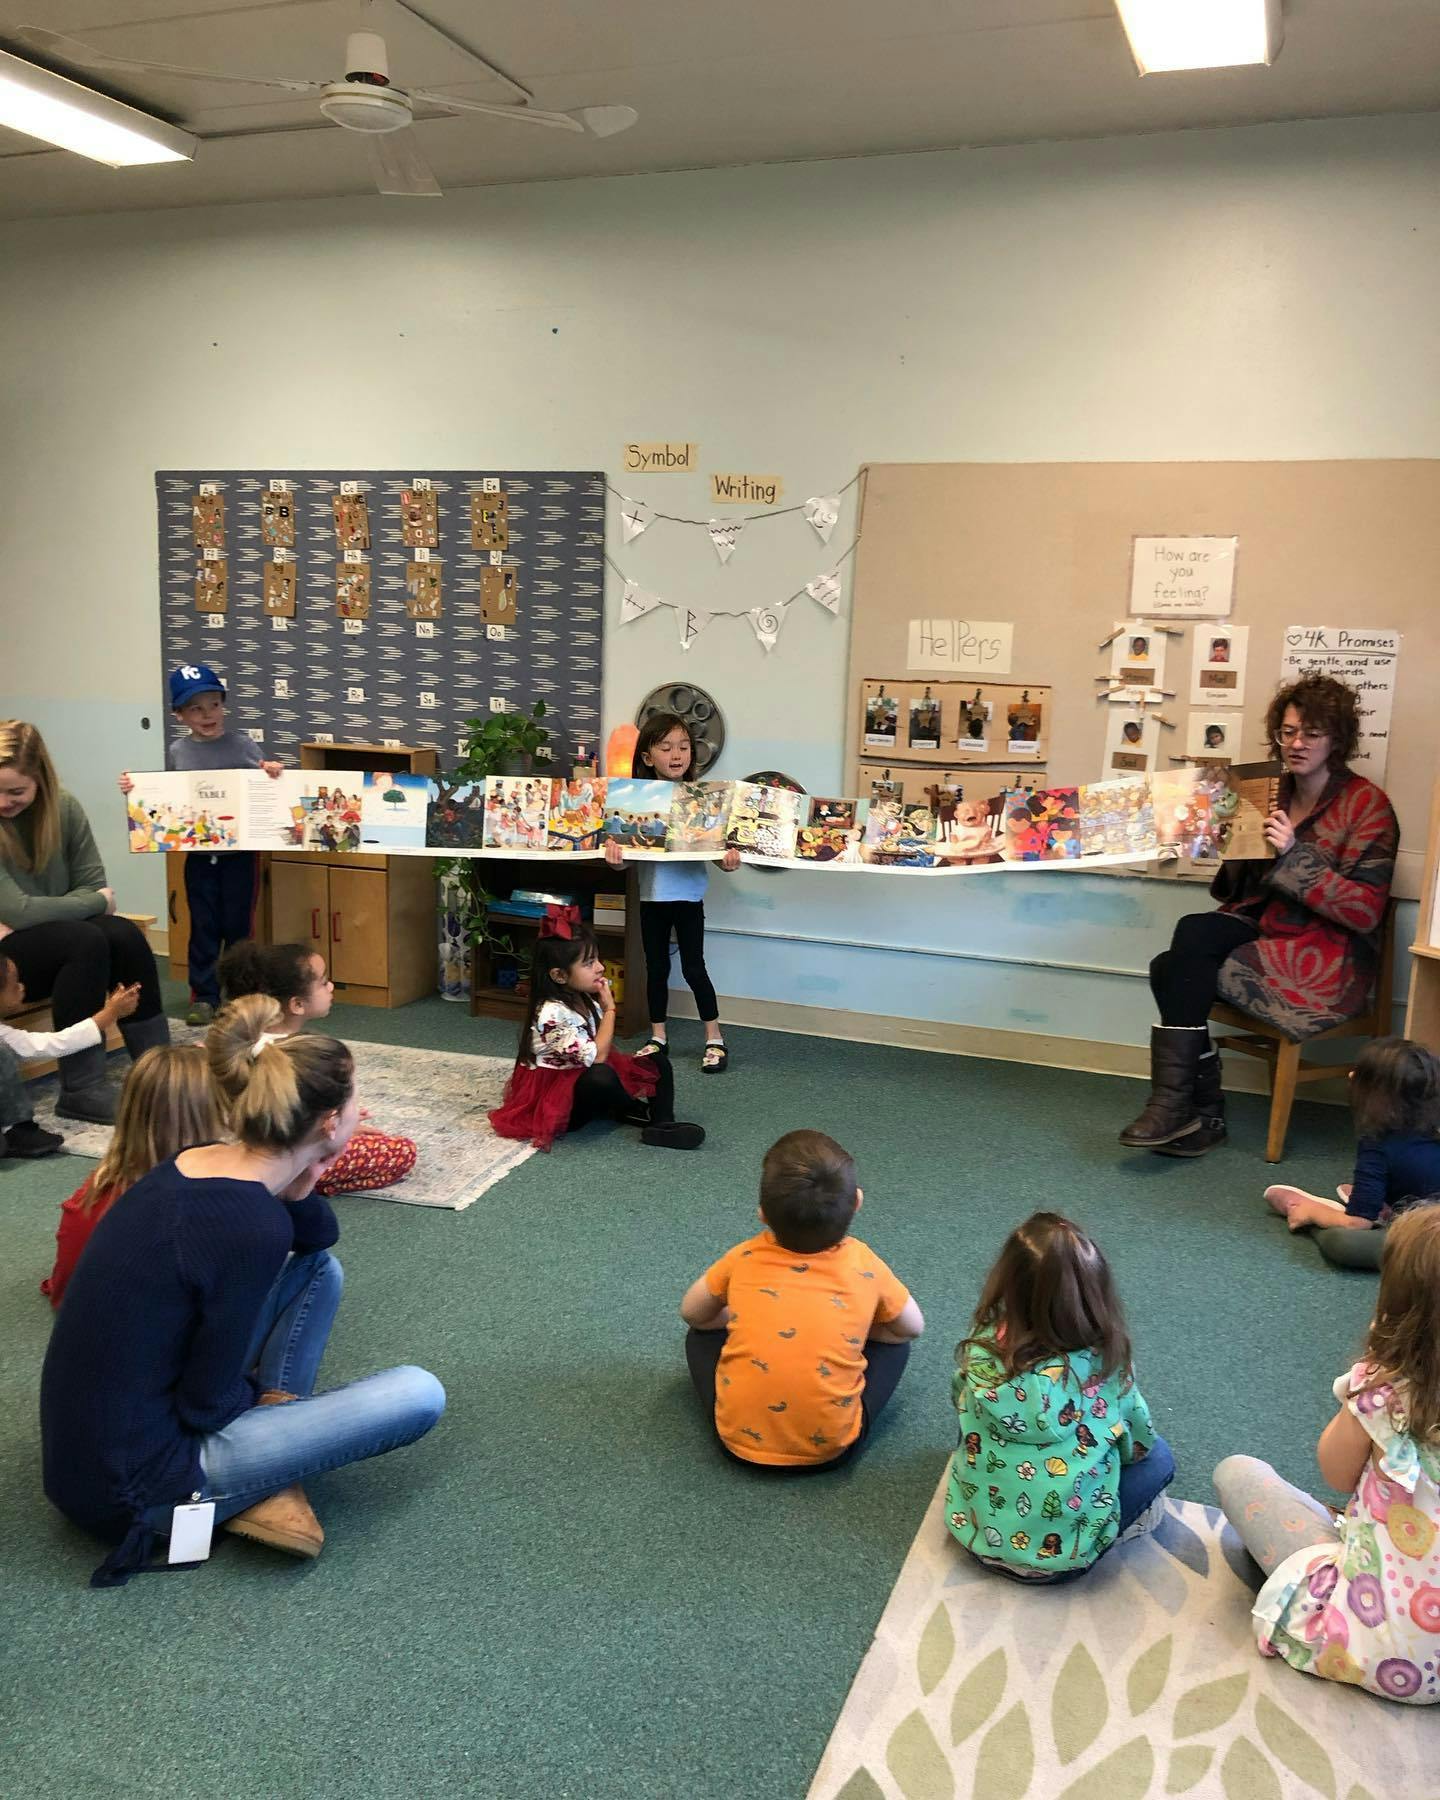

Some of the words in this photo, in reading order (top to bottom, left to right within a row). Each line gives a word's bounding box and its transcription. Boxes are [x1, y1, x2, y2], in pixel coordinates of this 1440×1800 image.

[628, 444, 689, 470] Symbol
[715, 475, 776, 504] Writing
[1154, 546, 1184, 562] How
[1189, 551, 1210, 562] are
[1169, 567, 1194, 584] you
[1153, 582, 1209, 601] feeling?
[1338, 631, 1394, 648] Promises
[1345, 657, 1368, 666] and
[1356, 680, 1388, 691] others
